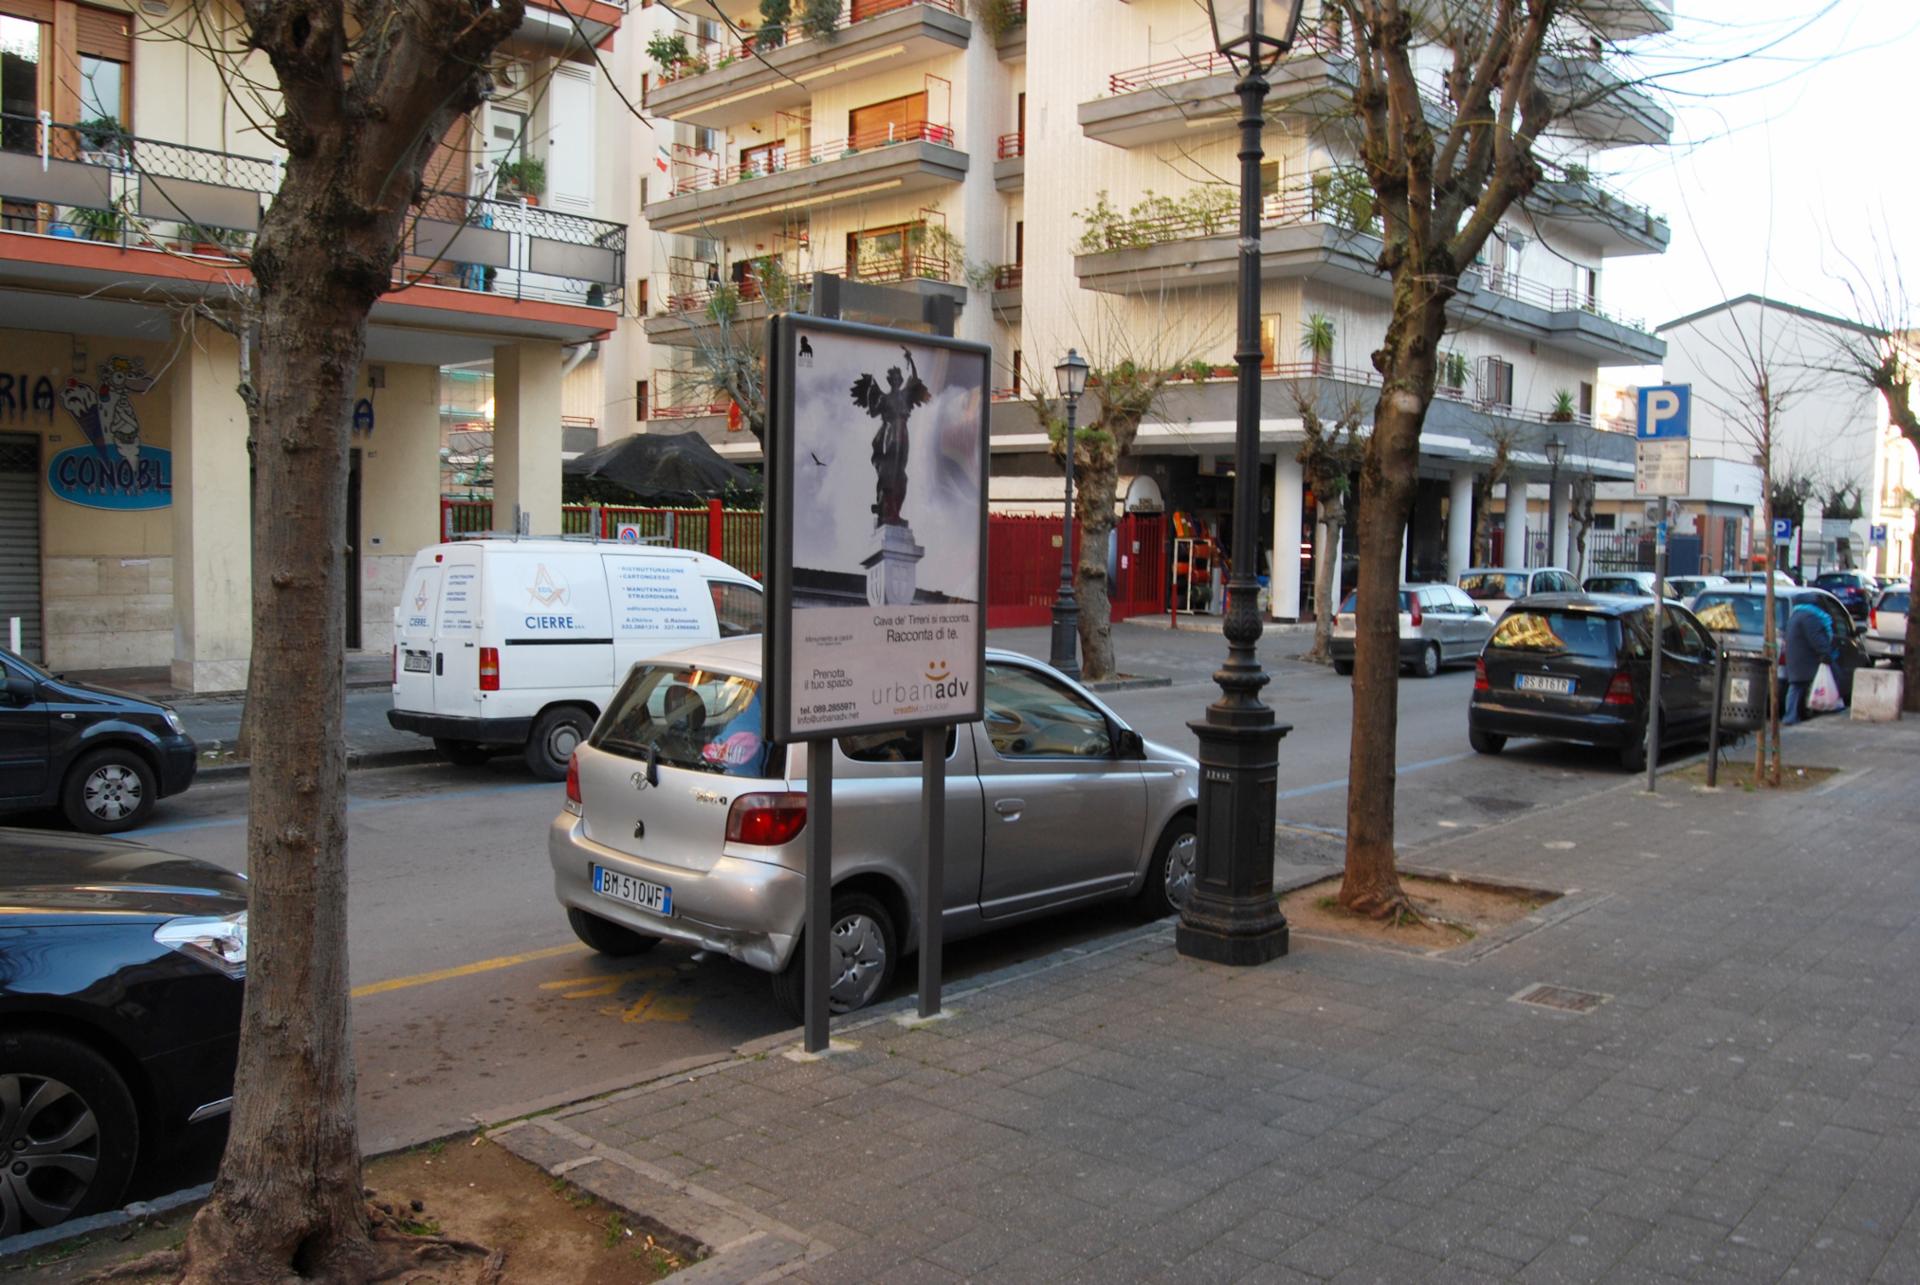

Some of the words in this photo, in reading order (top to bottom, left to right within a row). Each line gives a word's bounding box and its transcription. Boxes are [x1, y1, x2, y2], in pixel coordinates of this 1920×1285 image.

[1646, 390, 1680, 435] P
[1774, 521, 1787, 536] P
[1873, 526, 1884, 538] P
[525, 616, 574, 629] CIERRE
[873, 615, 893, 626] Cava
[908, 614, 930, 625] Tirreni
[931, 614, 938, 624] si
[887, 629, 933, 643] Racconta
[935, 627, 944, 640] di
[813, 668, 845, 680] Prenota
[804, 679, 809, 690] il
[811, 680, 825, 690] tuo
[827, 678, 853, 691] spazio
[872, 677, 969, 705] urbanadv
[603, 871, 619, 894] BM
[623, 879, 663, 908] 510WF
